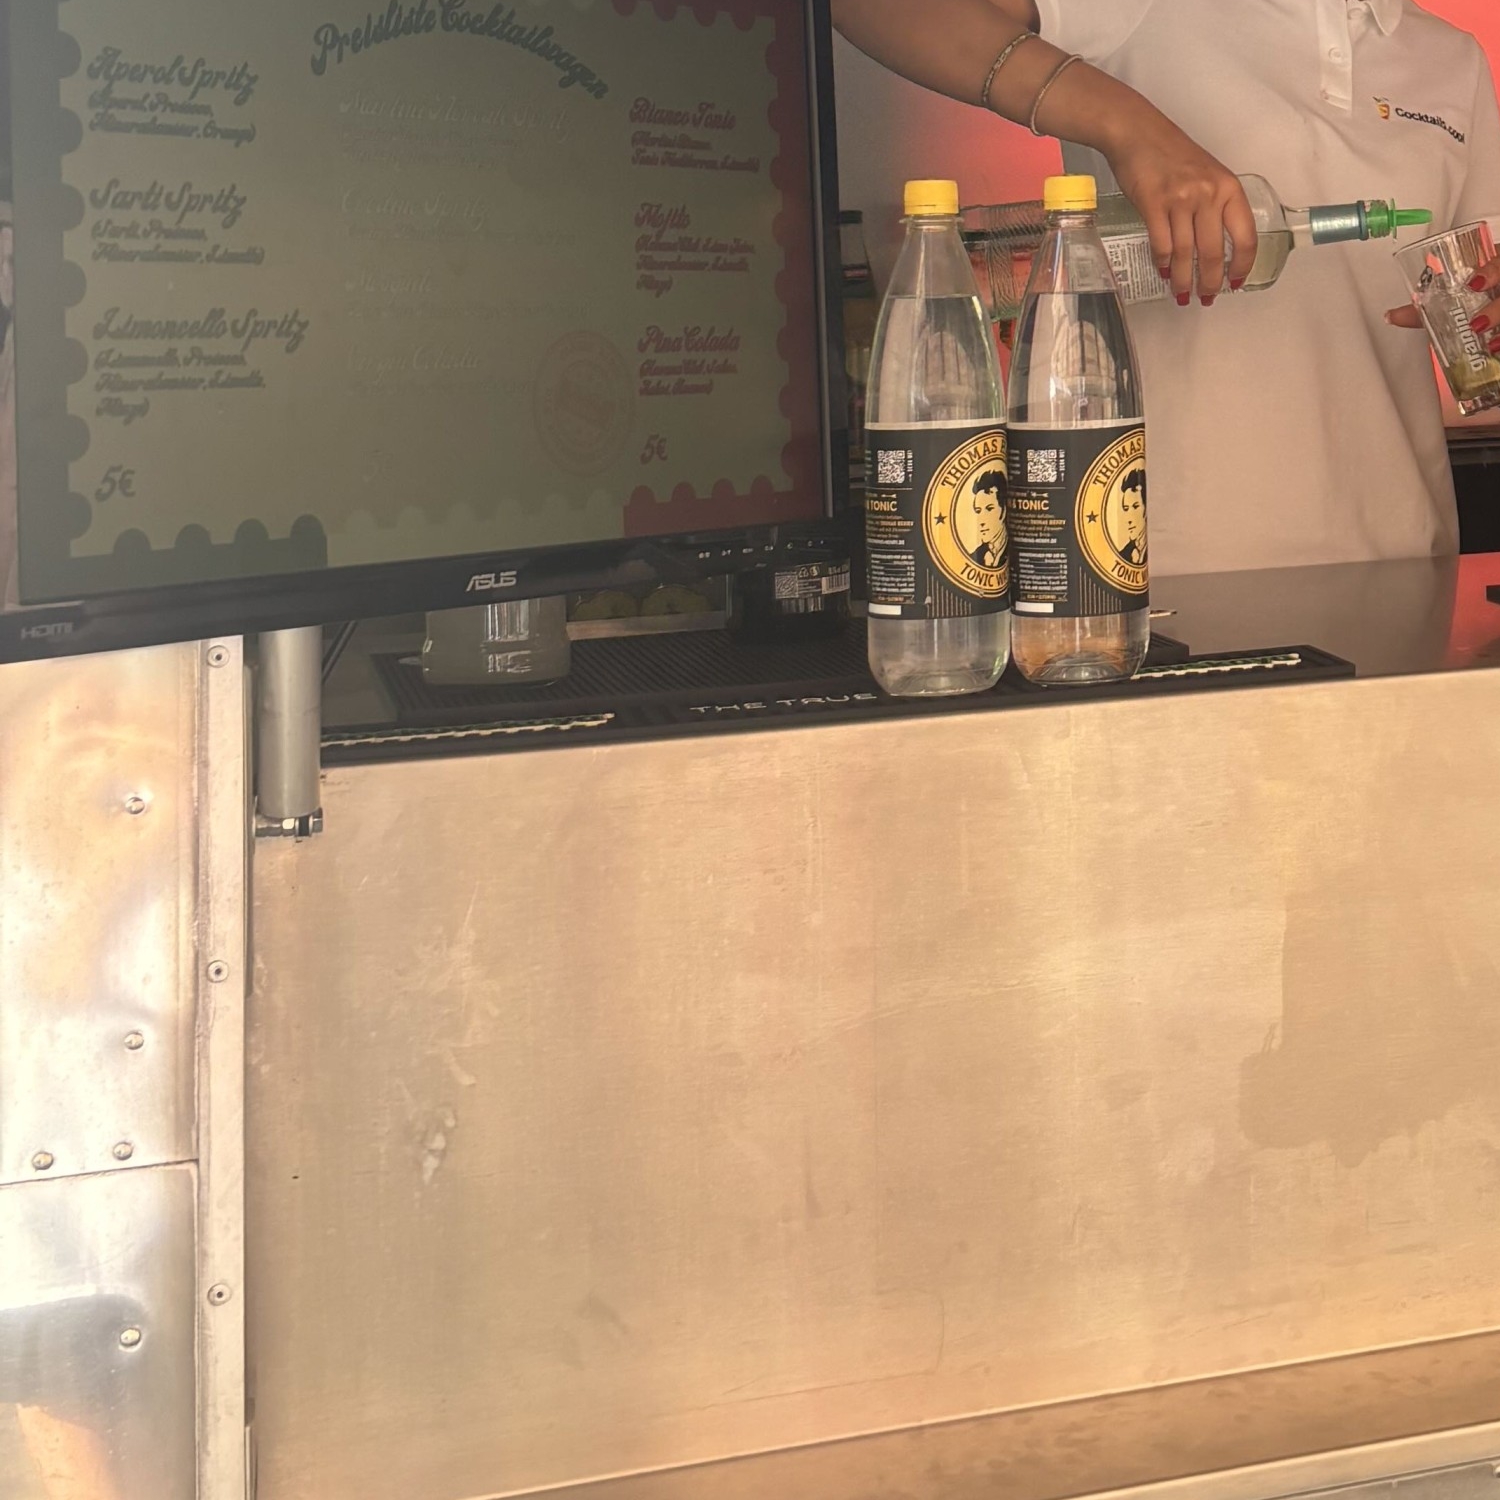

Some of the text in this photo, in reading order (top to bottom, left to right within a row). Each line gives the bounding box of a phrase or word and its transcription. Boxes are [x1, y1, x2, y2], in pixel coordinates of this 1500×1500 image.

[87, 46, 259, 106] Aperol Spritz
[165, 181, 248, 229] Spritz
[92, 307, 228, 336] Limoncello
[230, 308, 310, 353] Spritz
[683, 325, 742, 353] Colada
[941, 438, 998, 489] THOMAS
[1092, 437, 1142, 488] THOMAS
[95, 465, 137, 502] 5€
[869, 500, 898, 512] TONIC
[1018, 500, 1049, 511] TONIC
[465, 570, 517, 592] ASUS
[960, 563, 994, 588] TONIC
[1110, 560, 1139, 584] TONIC
[20, 621, 74, 639] HDMI
